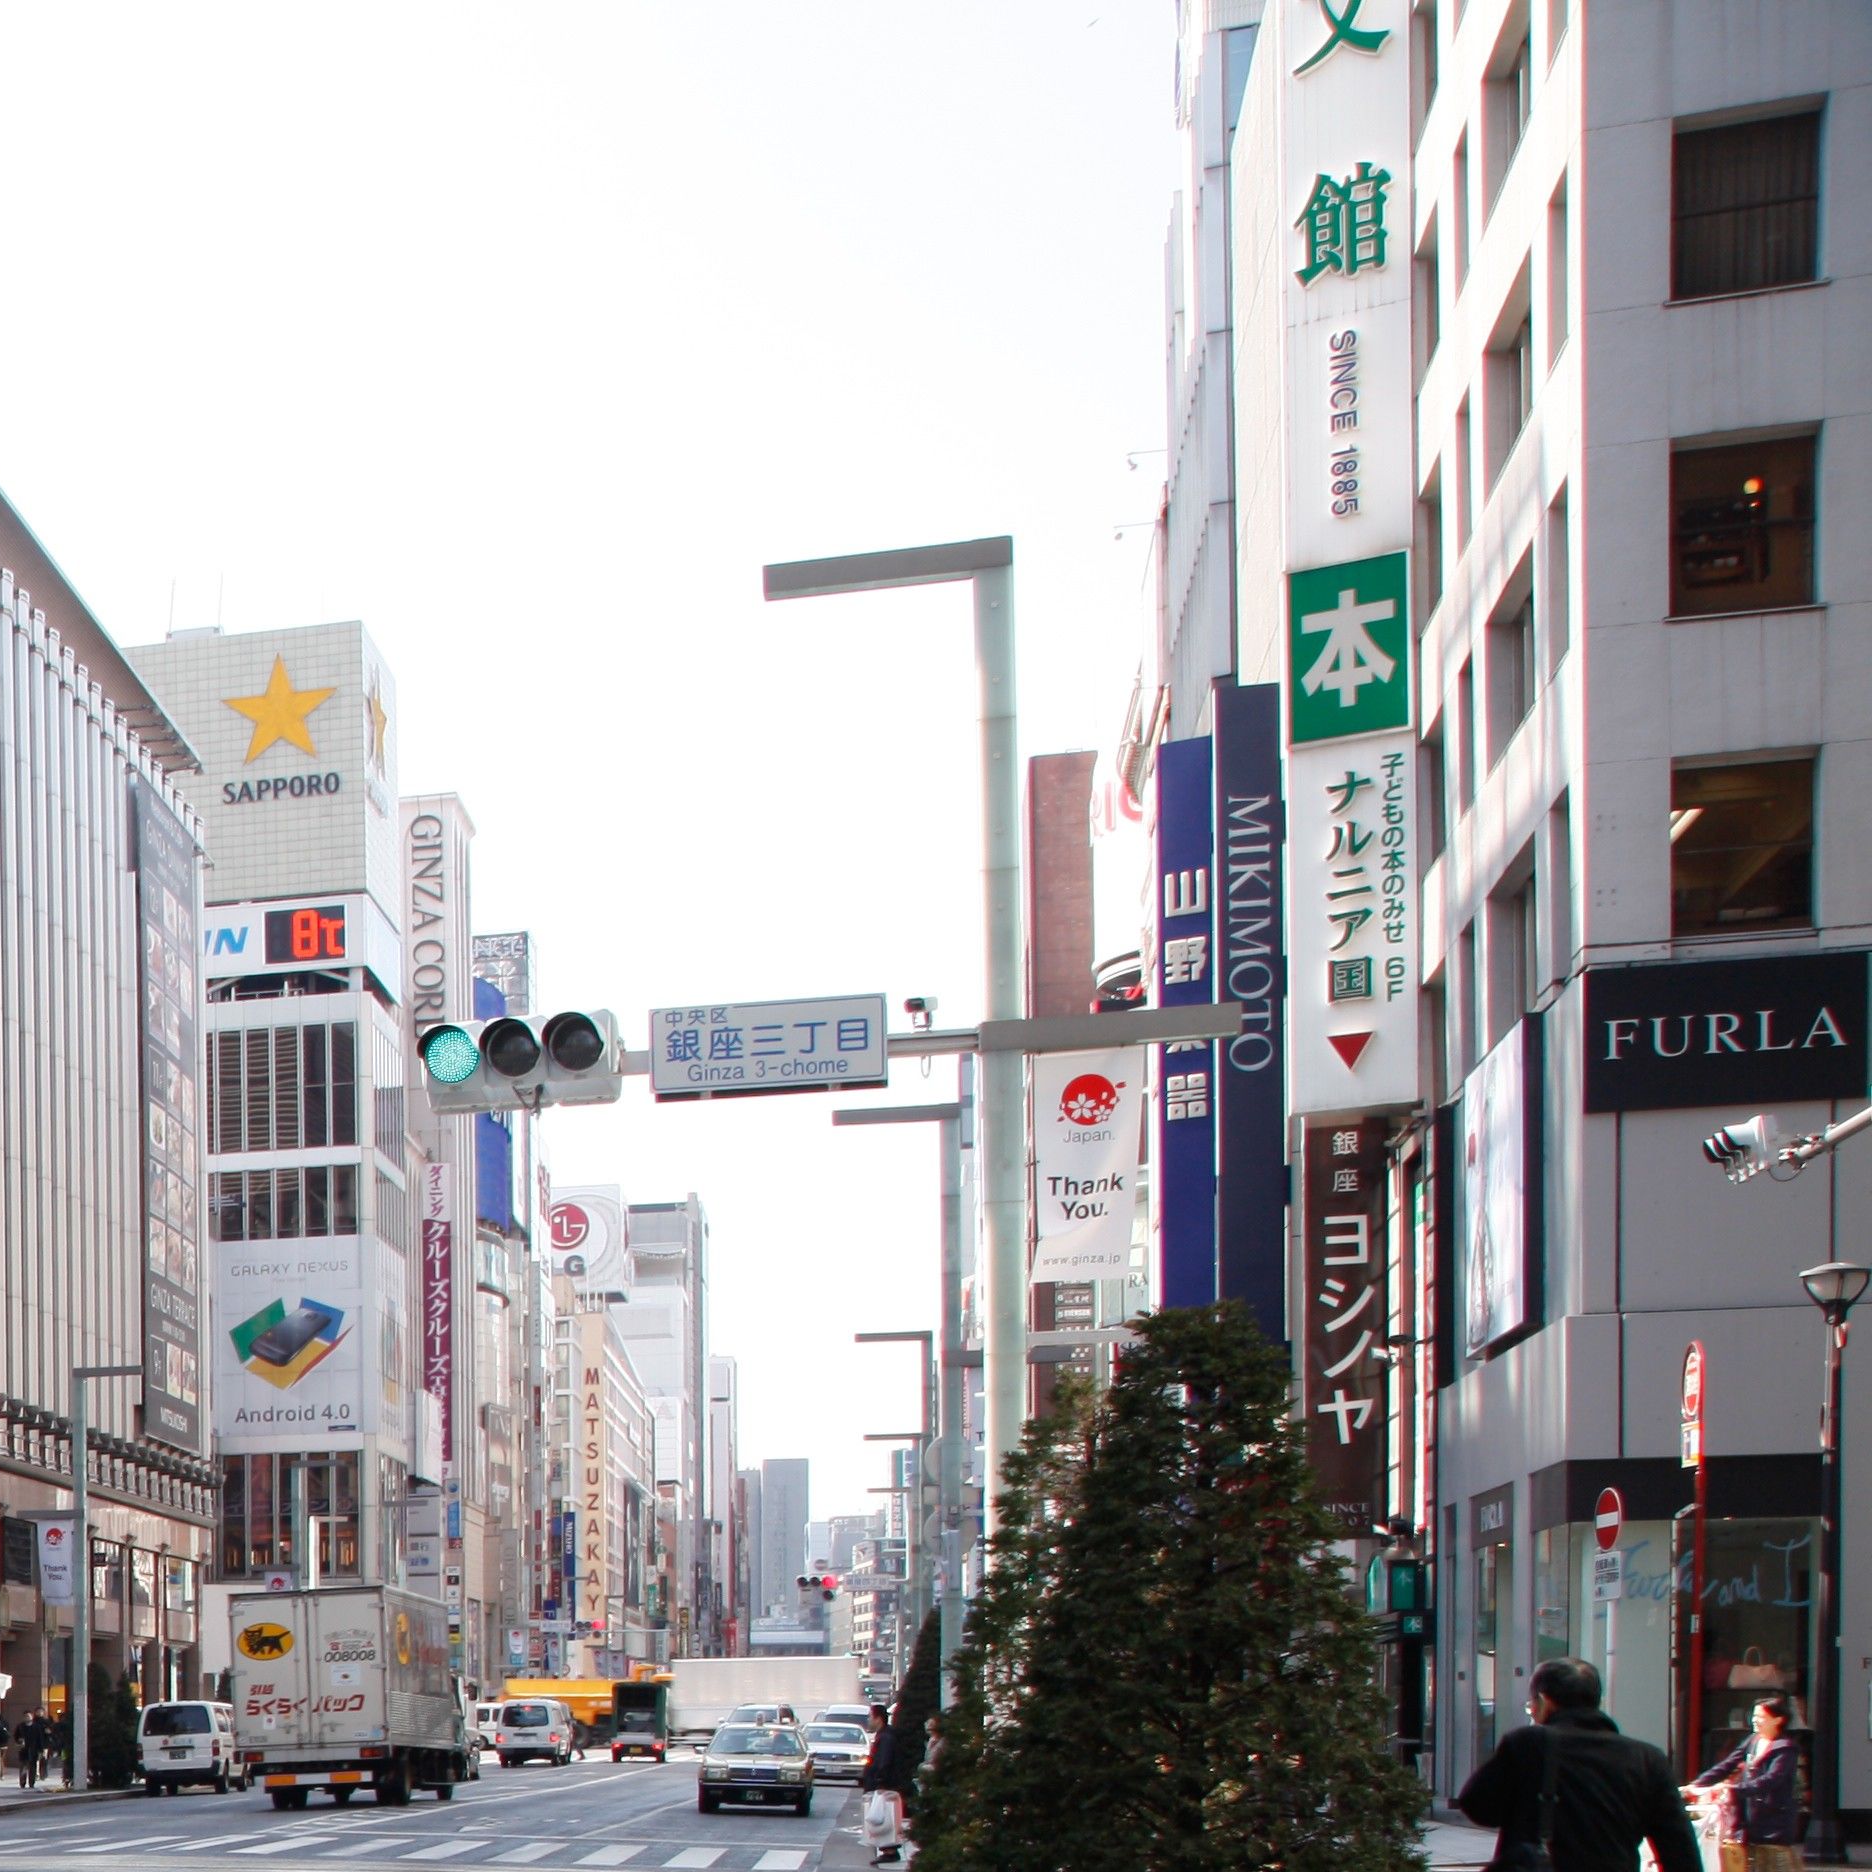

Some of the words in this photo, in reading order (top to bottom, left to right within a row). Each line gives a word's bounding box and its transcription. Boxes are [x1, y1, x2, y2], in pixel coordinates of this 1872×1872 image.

[1327, 329, 1359, 434] SINCE
[1330, 444, 1360, 519] 1885
[1300, 588, 1398, 708] 本
[221, 771, 341, 805] SAPPORO
[409, 813, 444, 932] GINZA
[1378, 752, 1406, 946] 子どもの本のみせ
[1325, 769, 1375, 1006] ナルニア国
[1224, 795, 1275, 1073] MIKIMOTO
[1386, 953, 1406, 1003] 6F
[664, 1006, 728, 1027] 中央区
[664, 1018, 870, 1063] 銀座三丁目
[1603, 1004, 1849, 1063] FURLA
[686, 1061, 746, 1083] Ginza
[754, 1056, 849, 1079] 3-chome
[1062, 1126, 1117, 1146] Japan.
[1047, 1172, 1125, 1198] Thank
[1330, 1130, 1360, 1194] 銀座
[1059, 1199, 1110, 1222] You.
[231, 1263, 290, 1278] GALAXY
[1041, 1253, 1122, 1267] www.ginza.jp
[1317, 1215, 1375, 1445] ヨシノヤ
[235, 1404, 315, 1424] Android
[320, 1403, 351, 1421] 4.0
[584, 1366, 601, 1613] MATSUZAKAY
[323, 1650, 377, 1664] 008008
